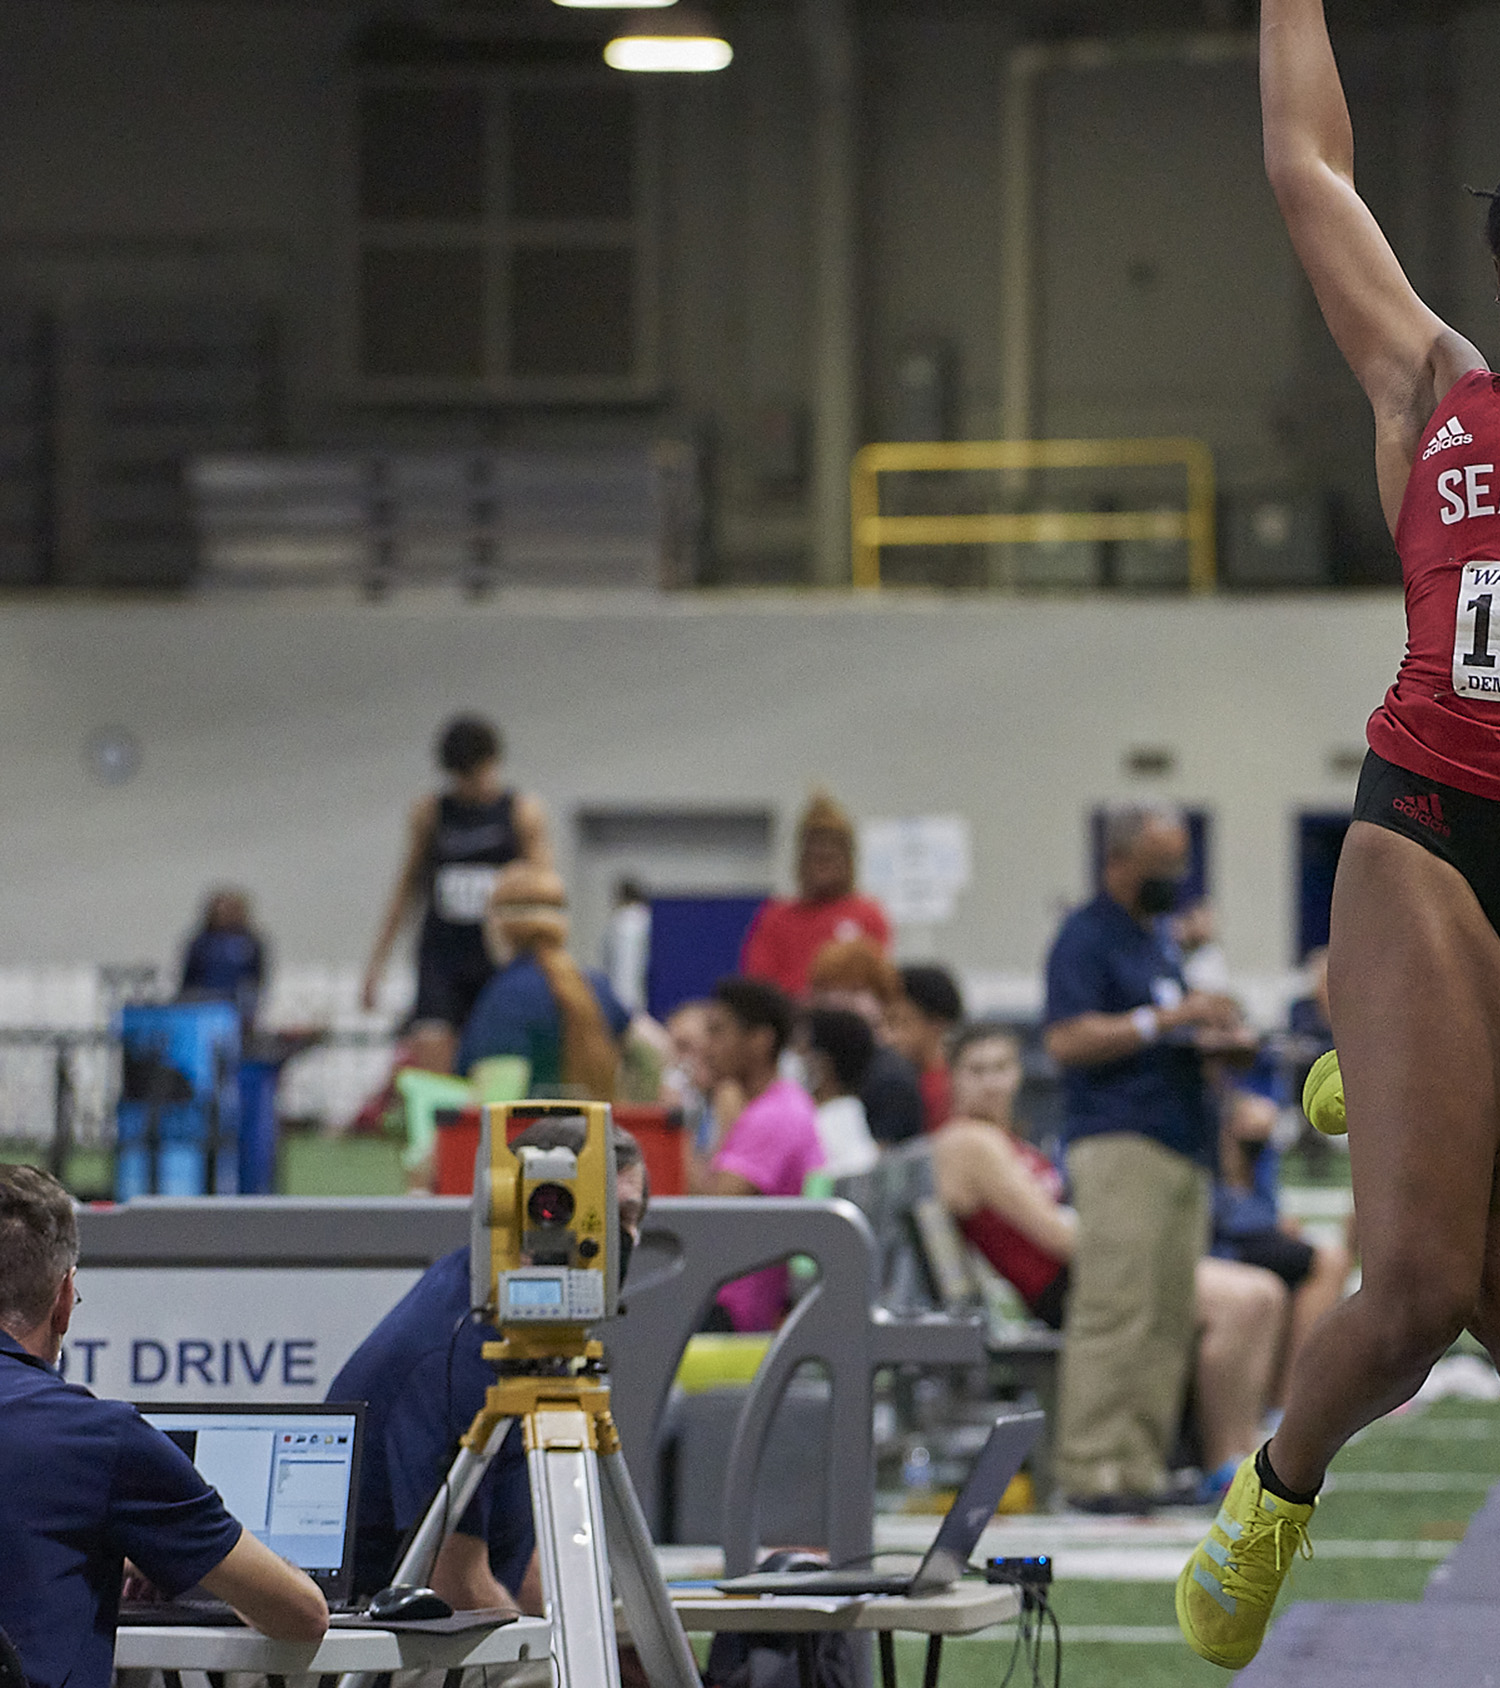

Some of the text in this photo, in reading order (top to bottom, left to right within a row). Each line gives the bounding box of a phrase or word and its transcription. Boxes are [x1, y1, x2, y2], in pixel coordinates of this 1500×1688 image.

[1422, 433, 1473, 460] adidas
[1392, 798, 1451, 838] adidas
[132, 1340, 316, 1385] DRIVE
